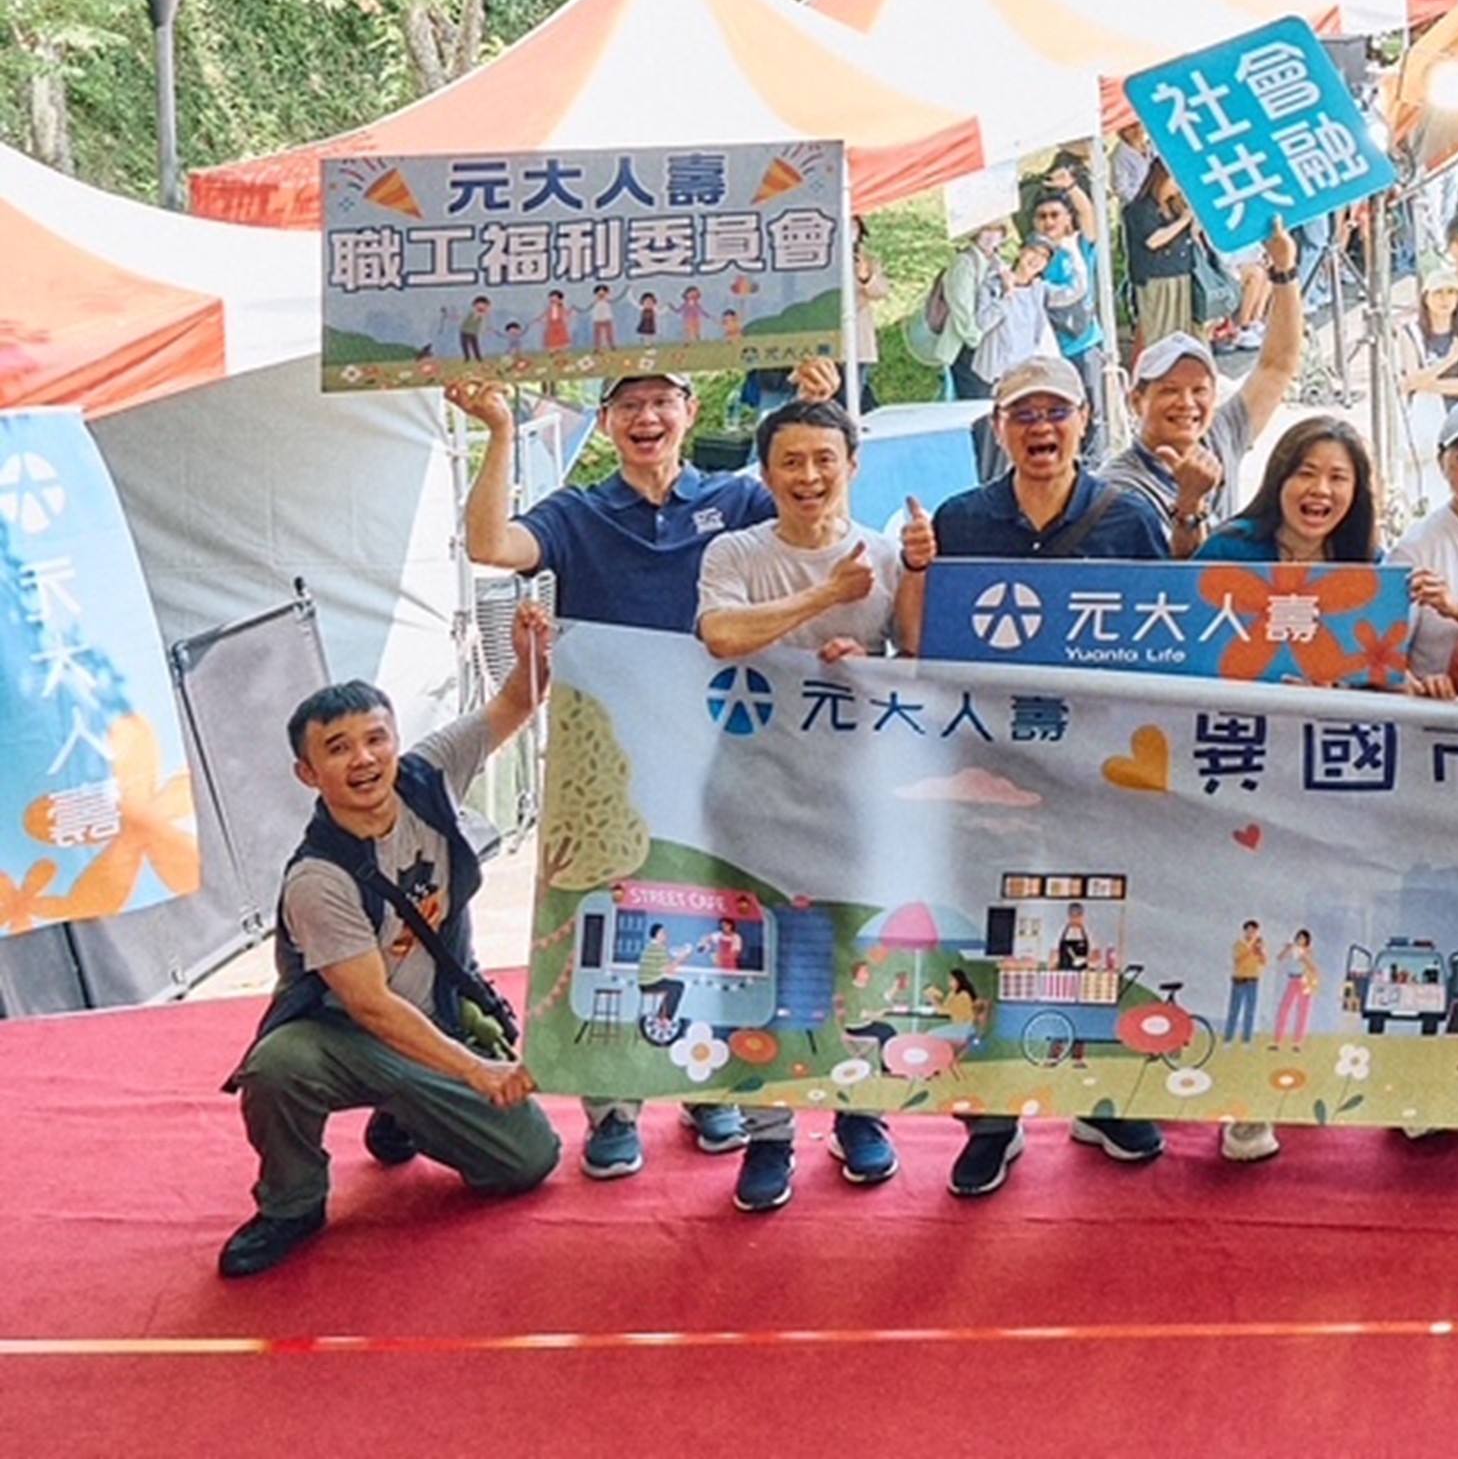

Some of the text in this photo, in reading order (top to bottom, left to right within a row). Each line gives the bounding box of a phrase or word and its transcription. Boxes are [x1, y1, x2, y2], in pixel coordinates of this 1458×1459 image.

[1151, 38, 1321, 151] 社會
[447, 151, 729, 215] 元大人壽
[1199, 117, 1370, 231] 共融
[328, 207, 838, 293] 職工福利委員會
[1066, 591, 1320, 643] 元大人壽
[1064, 646, 1187, 664] Yuanta Life
[20, 555, 122, 848] 元大人壽
[801, 680, 1070, 742] 元大人壽
[629, 886, 685, 908] STREET
